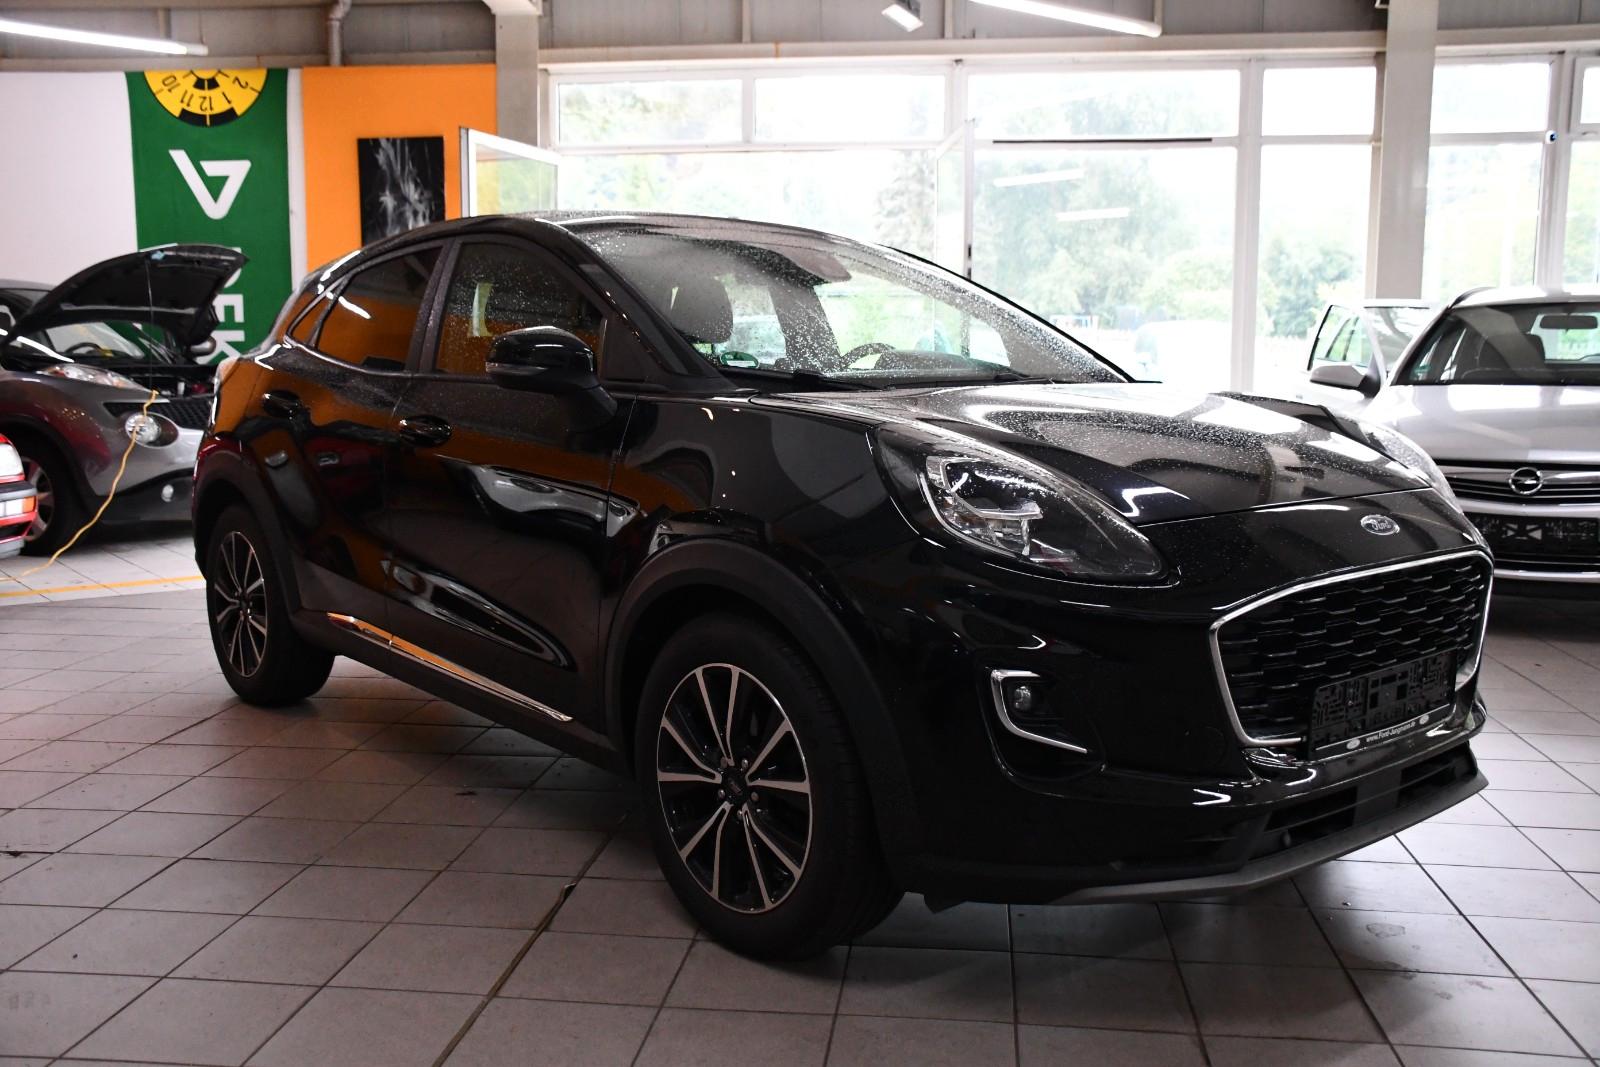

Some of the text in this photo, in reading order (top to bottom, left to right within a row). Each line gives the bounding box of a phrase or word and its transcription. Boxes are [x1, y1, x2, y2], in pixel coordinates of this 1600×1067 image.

[162, 75, 181, 92] 10
[232, 76, 249, 89] 2
[180, 90, 194, 107] 11
[199, 96, 214, 112] 12
[222, 91, 232, 104] 1
